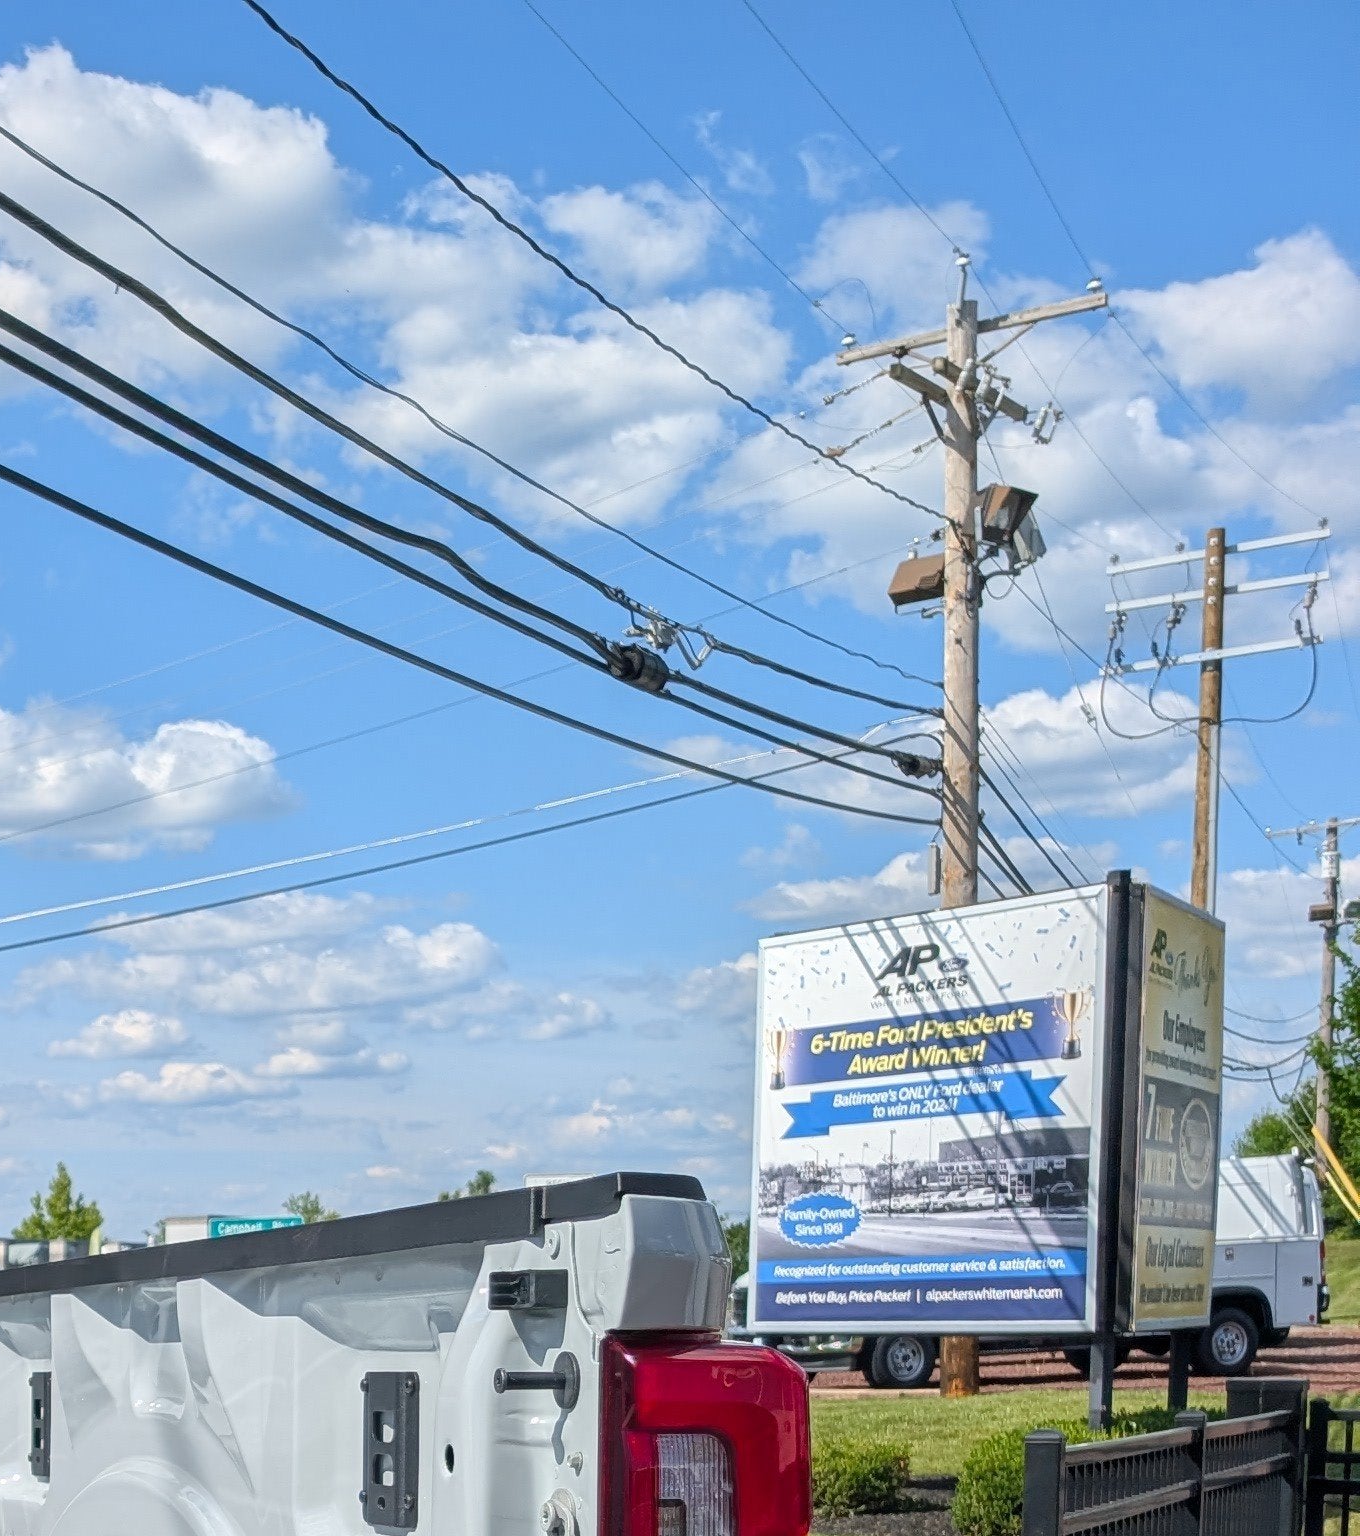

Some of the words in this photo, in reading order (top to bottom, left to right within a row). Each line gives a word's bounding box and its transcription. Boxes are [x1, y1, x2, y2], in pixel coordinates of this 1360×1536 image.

[875, 943, 940, 980] AP
[810, 1029, 874, 1055] 6-Time
[877, 1021, 920, 1046] Ford
[921, 1008, 1034, 1041] President's
[847, 1050, 908, 1075] Award
[912, 1039, 987, 1067] Winner!
[832, 1087, 897, 1108] Baltimore's
[899, 1082, 932, 1102] ONLY
[965, 1079, 1004, 1096] dealer
[872, 1106, 885, 1118] to
[887, 1103, 908, 1117] win
[909, 1101, 920, 1115] in
[784, 1206, 855, 1222] Family-Owned
[794, 1224, 822, 1236] Since
[774, 1264, 826, 1279] Recognized
[827, 1264, 841, 1277] for
[842, 1262, 901, 1276] outstanding
[901, 1261, 949, 1274] customer
[950, 1259, 986, 1272] service
[987, 1259, 997, 1271] &
[775, 1291, 807, 1305] Before
[808, 1291, 825, 1303] You
[848, 1290, 873, 1303] Price
